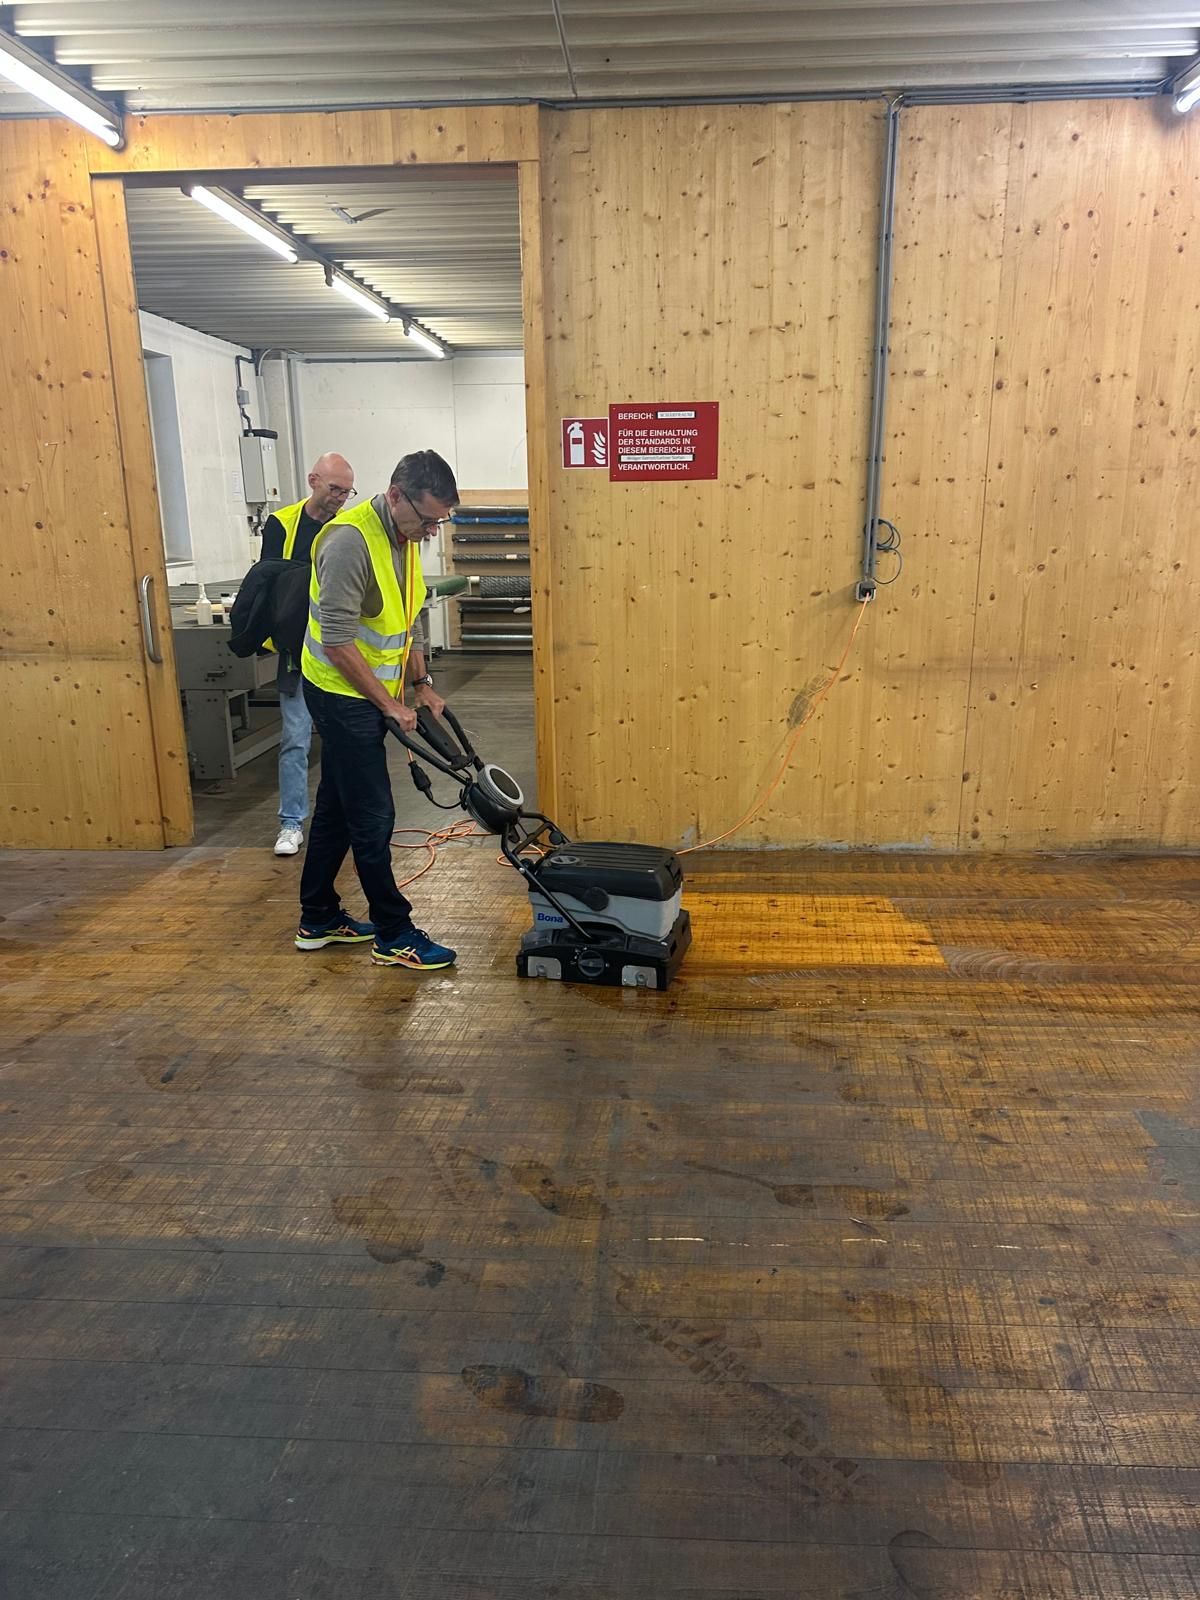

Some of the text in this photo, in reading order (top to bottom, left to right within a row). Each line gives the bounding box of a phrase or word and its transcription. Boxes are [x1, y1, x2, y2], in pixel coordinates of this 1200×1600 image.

[618, 429, 634, 437] FÜR
[635, 429, 648, 437] DIE
[618, 438, 634, 446] DER
[649, 446, 682, 454] BEREICH
[618, 463, 690, 471] VERANTWORTLICH.
[537, 913, 564, 923] Bona
